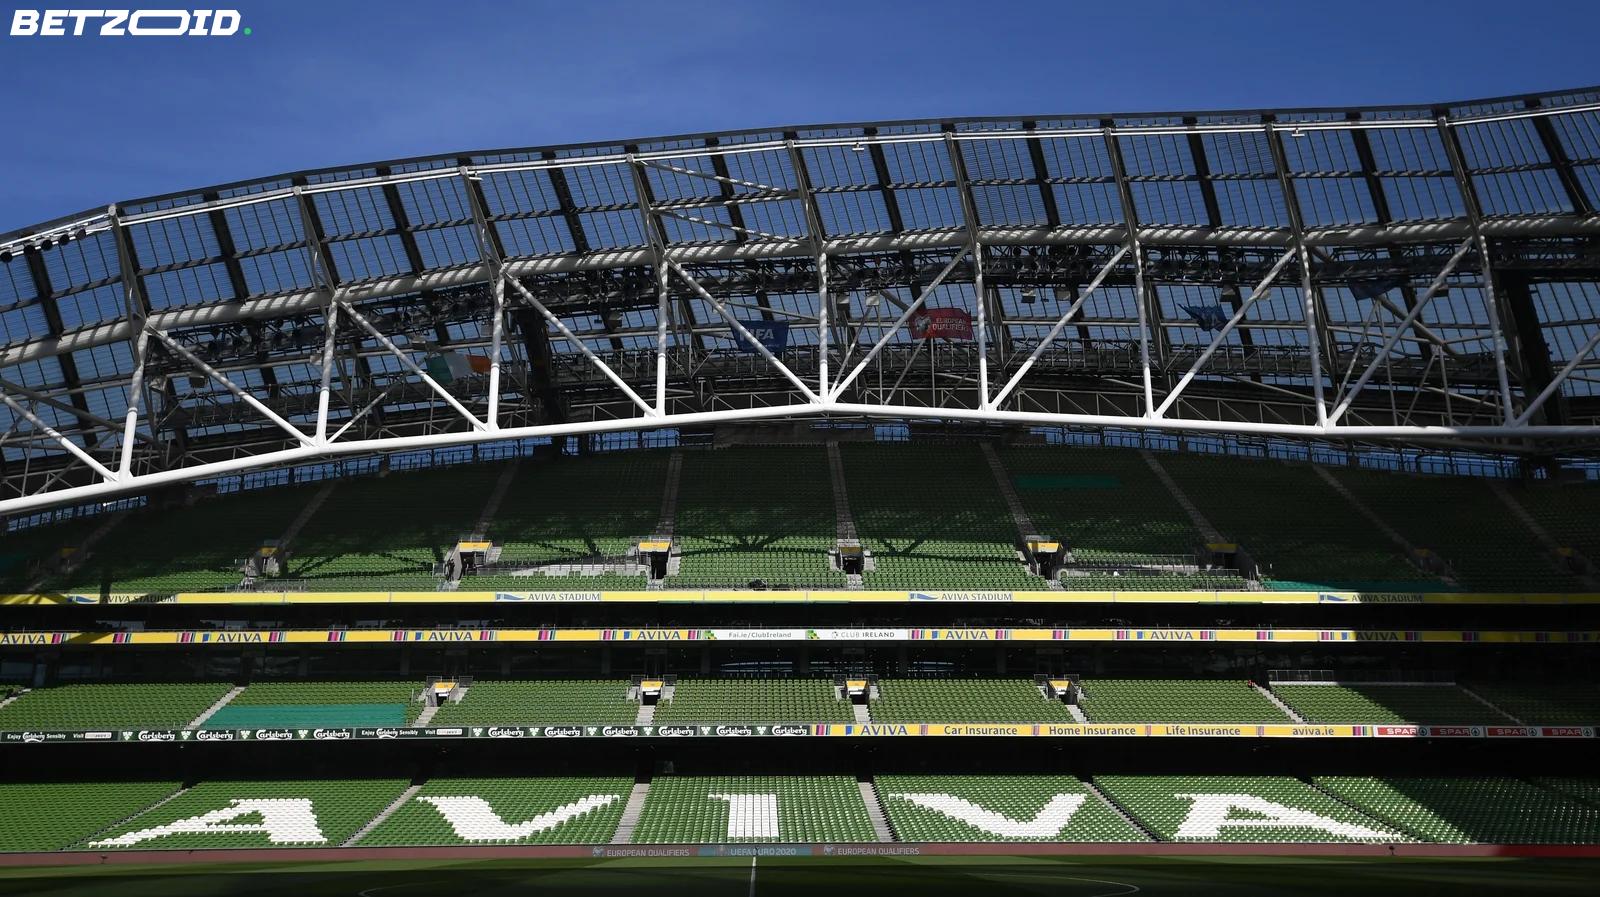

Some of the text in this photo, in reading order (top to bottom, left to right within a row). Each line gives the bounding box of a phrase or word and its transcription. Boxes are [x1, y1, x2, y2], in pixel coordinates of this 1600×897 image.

[528, 593, 600, 601] AVIVA STADIUM
[941, 593, 1012, 601] AVIVA STADIUM
[1351, 594, 1423, 602] AVIVA STADIUM
[0, 634, 46, 644] AVIVA
[217, 633, 261, 642] AVIVA
[429, 631, 473, 641] AVIVA
[637, 630, 681, 640] AVIVA
[945, 630, 989, 640] AVIVA
[1150, 631, 1193, 640] AVIVA
[1357, 631, 1399, 641] AVIVA
[138, 730, 175, 740] Carlsberg
[196, 729, 234, 740] Carlsberg
[255, 729, 293, 740] Carlsberg
[313, 728, 350, 739] Carlsberg
[376, 728, 399, 738] Carlsberg
[487, 726, 525, 737] Carlsberg
[544, 726, 581, 737] Carlsberg
[602, 726, 639, 737] Carlsberg
[658, 726, 695, 736] Carlsberg
[716, 726, 752, 736] Carlsberg
[771, 725, 808, 736] Carlsberg
[860, 725, 908, 735] AVIVA
[944, 725, 1018, 735] Car Insurance
[1049, 725, 1136, 735] Home Insurance
[1165, 725, 1241, 735] Life Insurance
[1292, 726, 1334, 735] aviva.ie
[1386, 727, 1417, 735] SPAR
[1439, 727, 1470, 735] SPAR
[23, 731, 46, 741] Carlsberg
[88, 792, 1410, 845] AVIVA
[607, 849, 690, 857] EUROPEAN QUALIFIERS
[730, 848, 752, 856] UEFA
[776, 848, 797, 856] 2020
[837, 847, 920, 855] EUROPEAN QUALIFIERS
